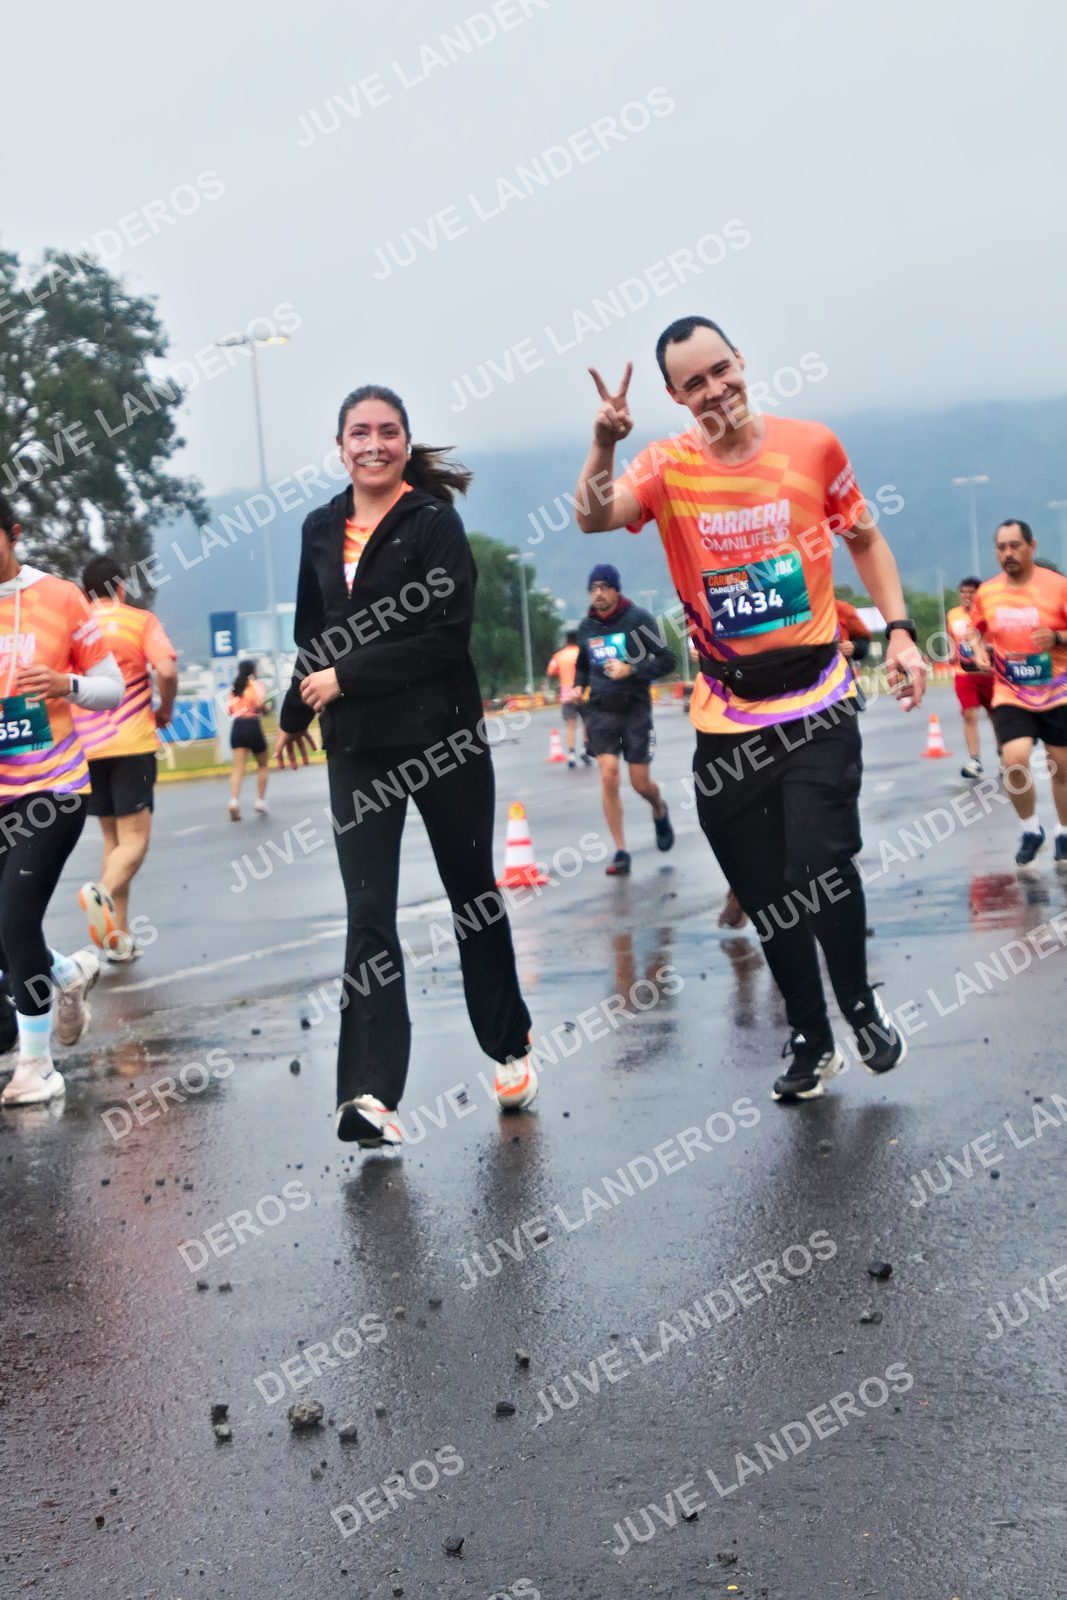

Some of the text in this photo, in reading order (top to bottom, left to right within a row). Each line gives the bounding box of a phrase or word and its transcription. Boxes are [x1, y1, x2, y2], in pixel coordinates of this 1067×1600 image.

[698, 498, 790, 535] CARRERA
[708, 571, 748, 586] CARRERA
[722, 588, 784, 618] 1434
[215, 630, 232, 653] E
